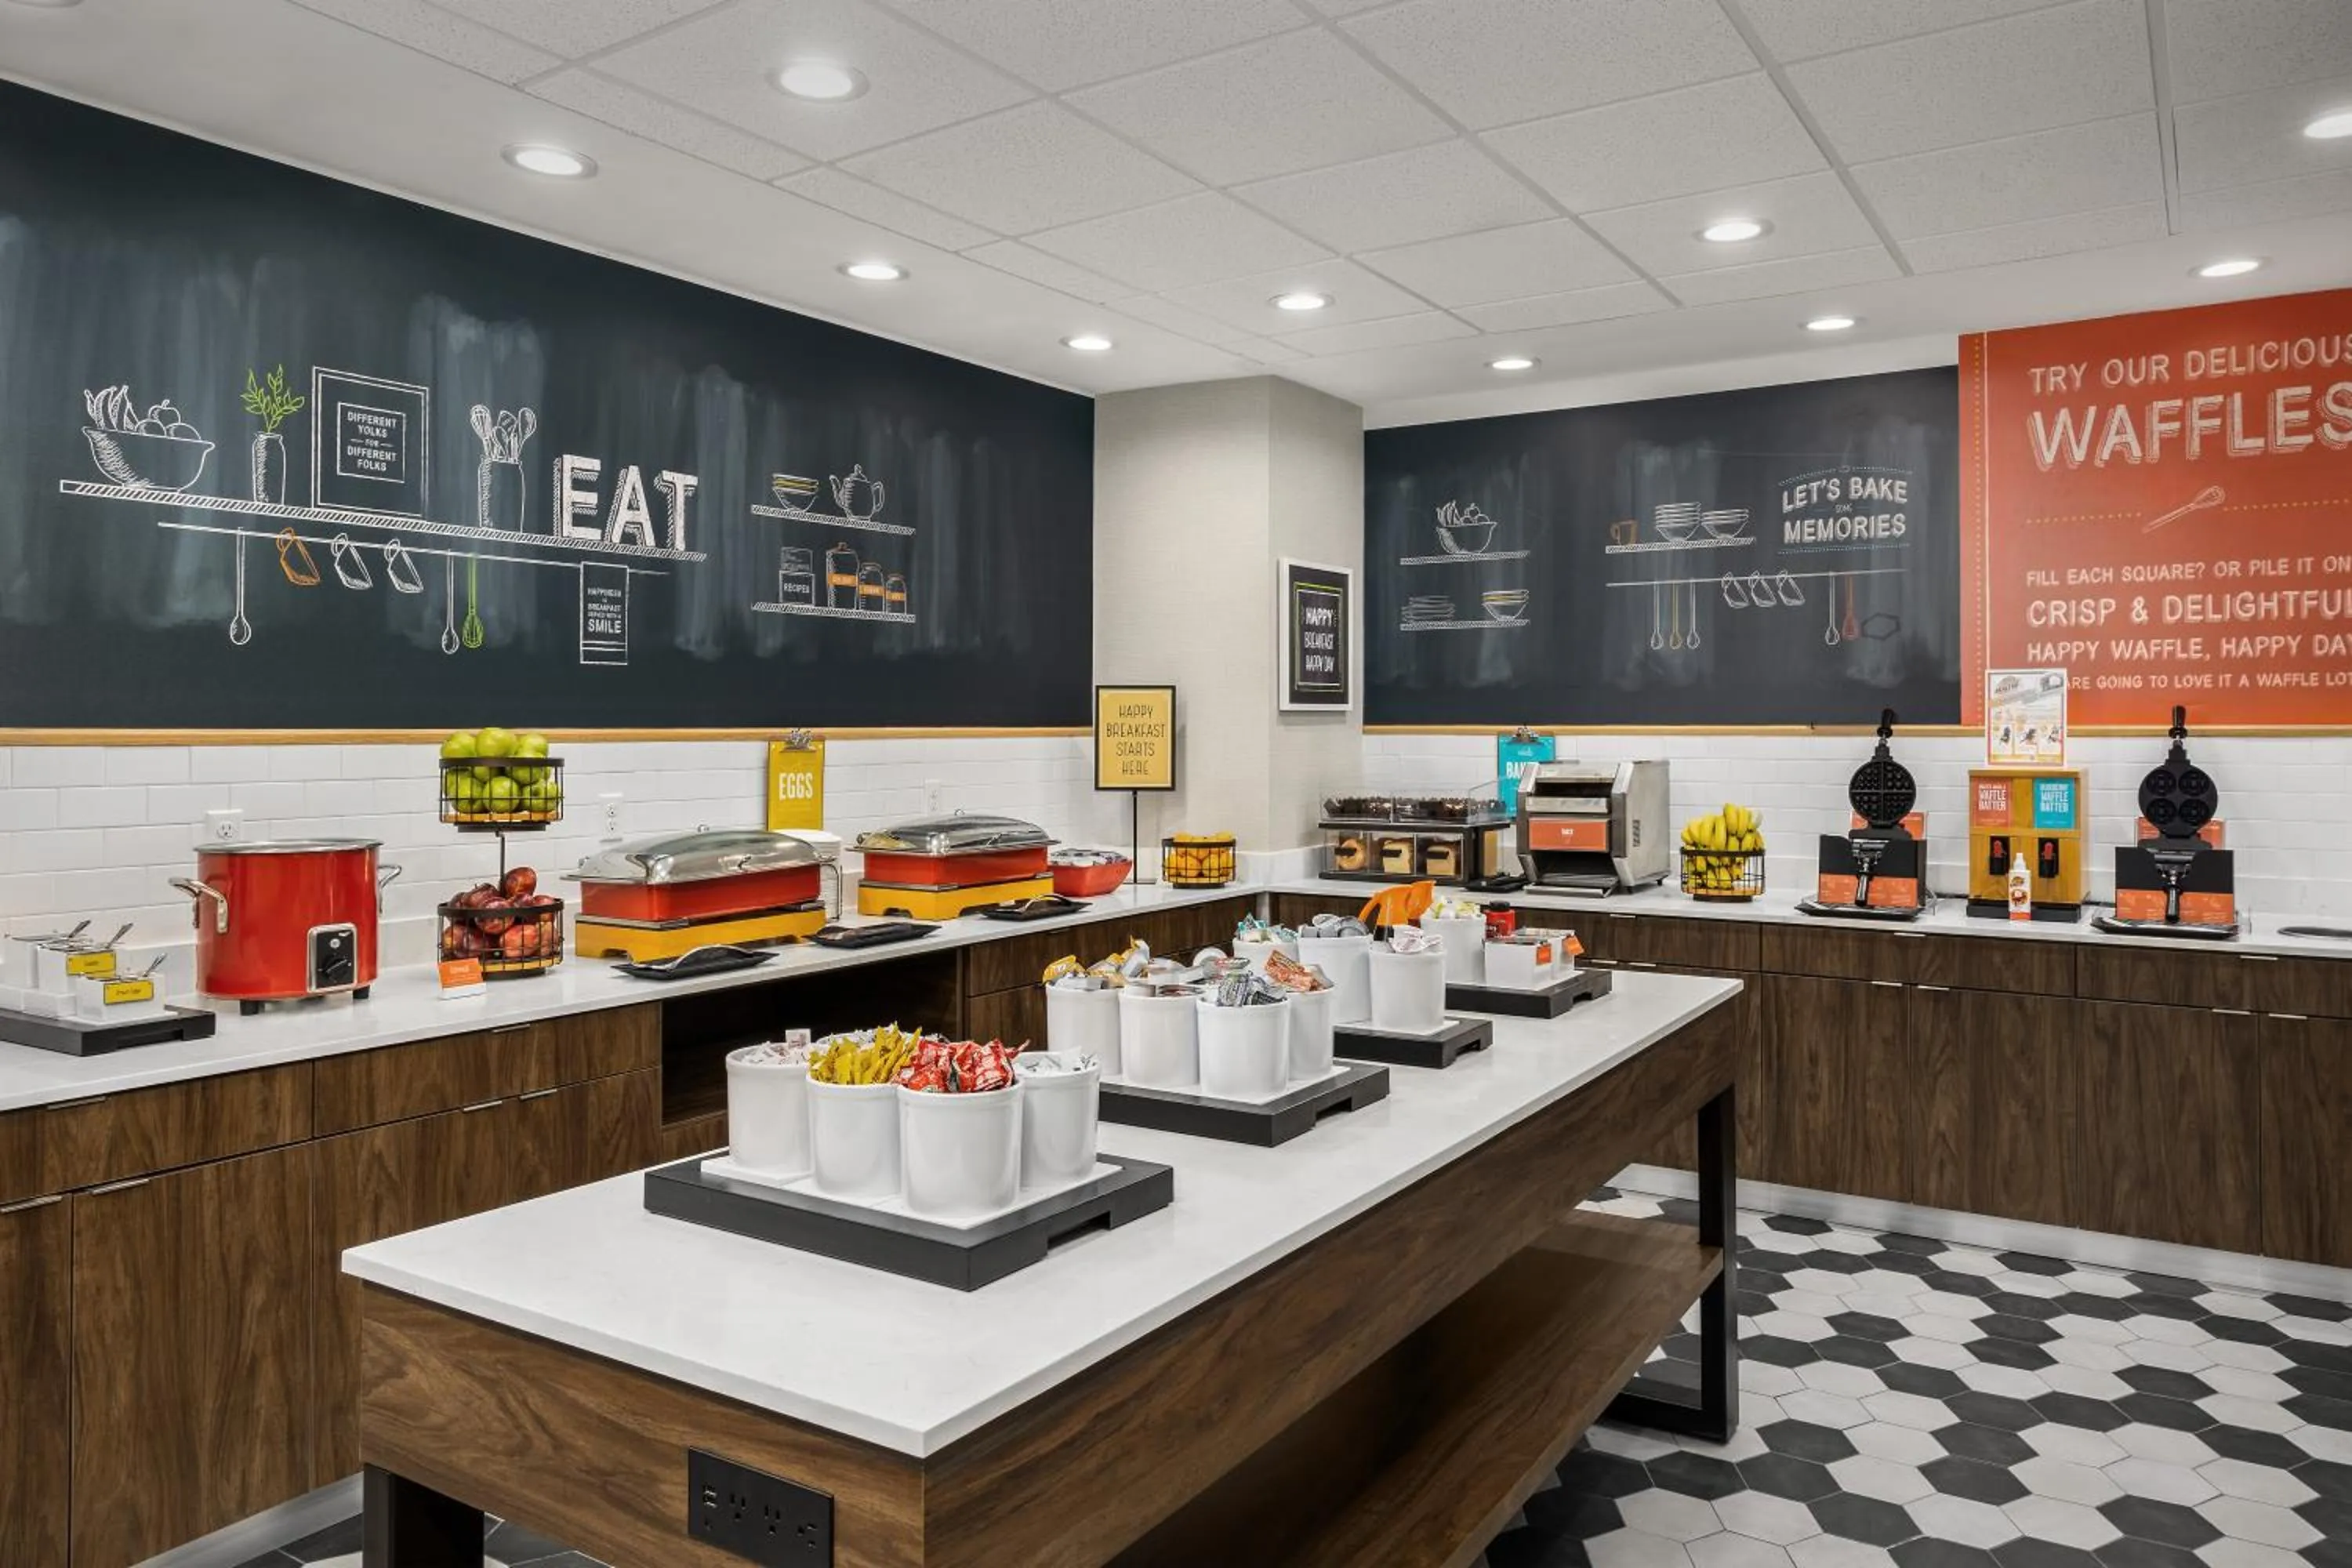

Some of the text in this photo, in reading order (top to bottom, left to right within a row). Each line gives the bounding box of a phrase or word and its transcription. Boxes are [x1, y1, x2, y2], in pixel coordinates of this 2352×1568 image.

[2028, 361, 2088, 396] TRY
[2101, 354, 2170, 387] OUR
[347, 411, 397, 429] DIFFERENT
[2027, 381, 2352, 472] WAFFLES
[358, 424, 388, 438] YOLKS
[365, 439, 379, 448] FOR
[347, 445, 397, 462] DIFFERENT
[358, 459, 387, 471] FOLKS
[553, 454, 699, 552] EAT
[1782, 477, 1907, 514] LET'S BAKE
[1784, 513, 1906, 544] MEMORIES
[2027, 570, 2060, 587] FILL
[2067, 567, 2113, 585] EACH
[2122, 562, 2205, 583] SQUARE?
[2214, 560, 2241, 578] OR
[2249, 557, 2289, 577] PILE
[2297, 557, 2314, 575] IT
[1305, 607, 1332, 627] HAPPY
[2027, 598, 2117, 627] CRISP
[2131, 596, 2149, 622] &
[588, 619, 622, 634] SMILE
[2027, 640, 2100, 662] HAPPY
[2111, 637, 2210, 662] WAFFLE,
[2220, 634, 2302, 659] HAPPY
[2096, 675, 2143, 690] GOING
[2149, 675, 2168, 689] TO
[2174, 673, 2213, 688] LOVE
[2219, 673, 2233, 688] IT
[2238, 673, 2250, 688] A
[2256, 672, 2320, 688] WAFFLE
[1119, 705, 1153, 718] HAPPY
[1106, 723, 1165, 738] BREAKFAST
[1116, 742, 1155, 757] STARTS
[1122, 760, 1149, 775] HERE
[779, 771, 813, 800] EGGS
[1979, 789, 2006, 800] WAFFLE
[2041, 791, 2069, 802] WAFFLE
[1978, 800, 2006, 811] BATTER
[2040, 801, 2069, 813] BATTER
